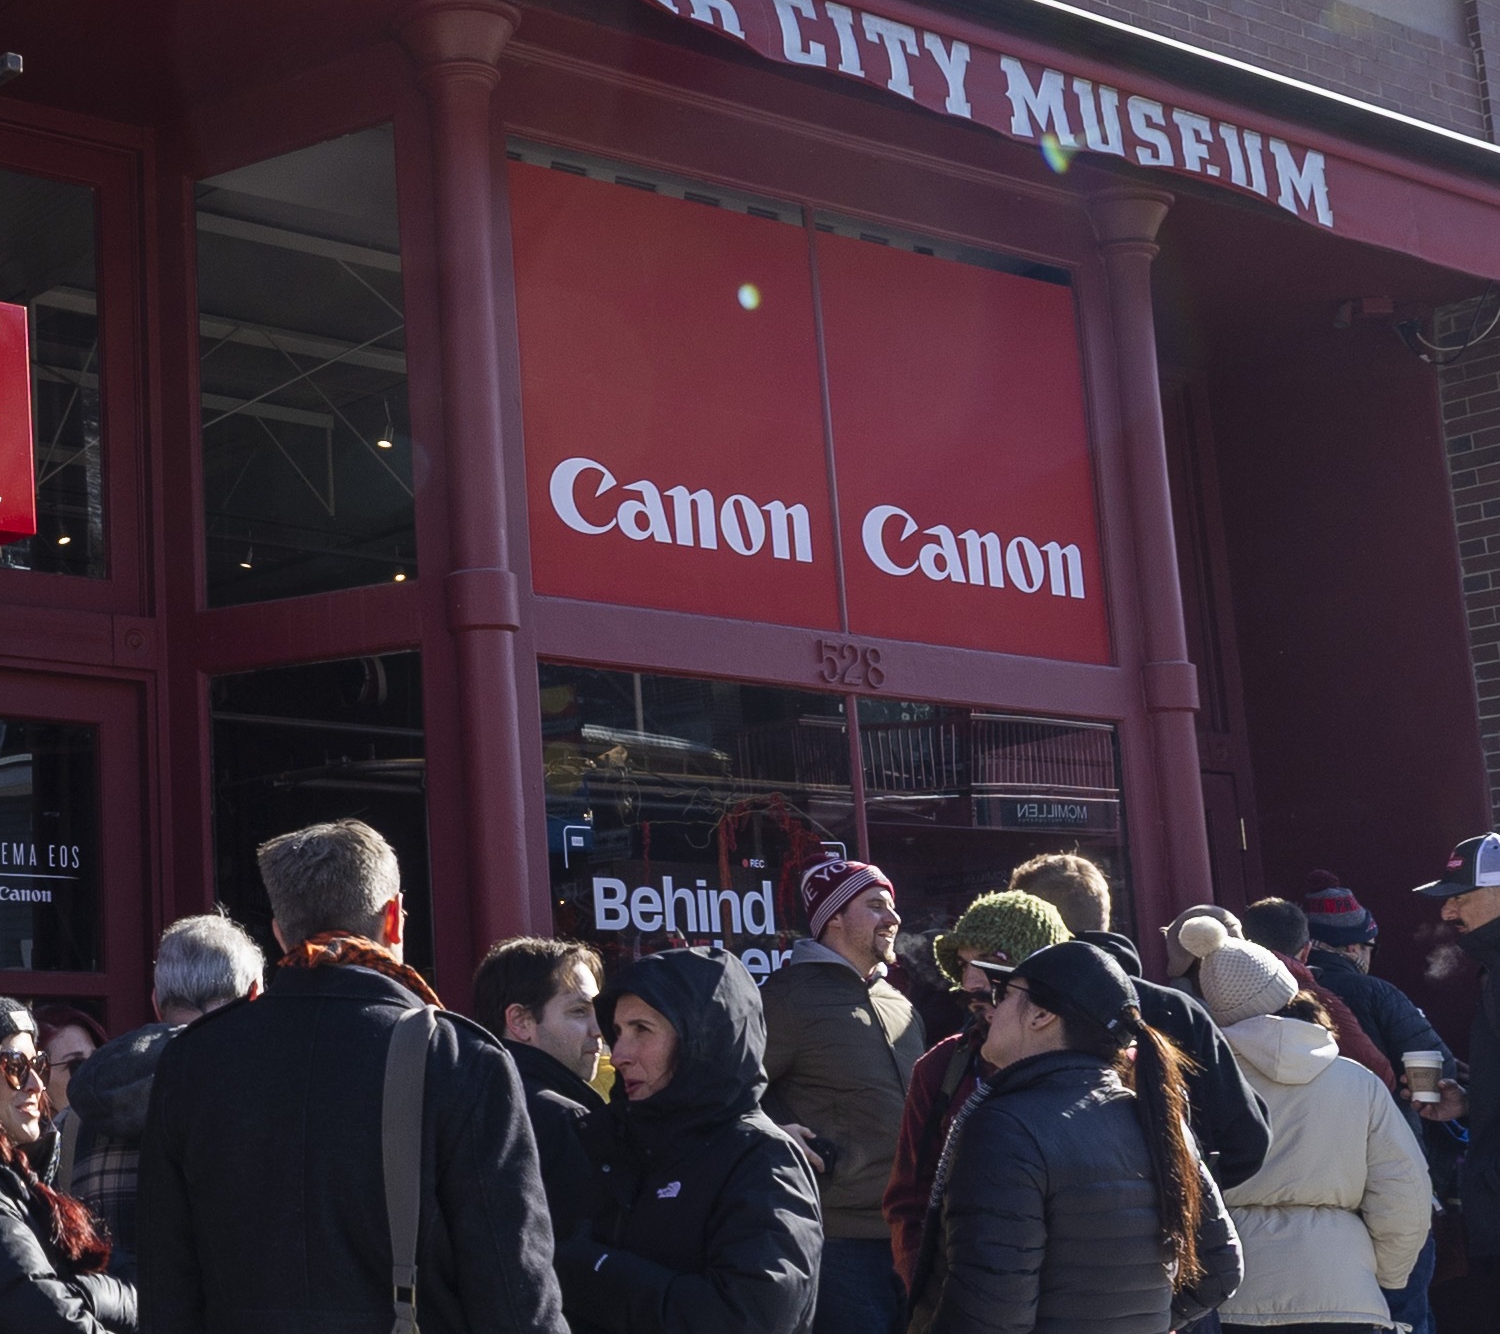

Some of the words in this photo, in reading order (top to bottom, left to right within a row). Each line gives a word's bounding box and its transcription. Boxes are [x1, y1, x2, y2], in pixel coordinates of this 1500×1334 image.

[1001, 57, 1335, 228] MUSEUM
[549, 457, 814, 564] Canon
[862, 504, 1086, 600] Canon
[815, 639, 886, 689] 528
[48, 844, 80, 869] EOS
[750, 858, 765, 869] REC
[592, 875, 776, 936] Behind
